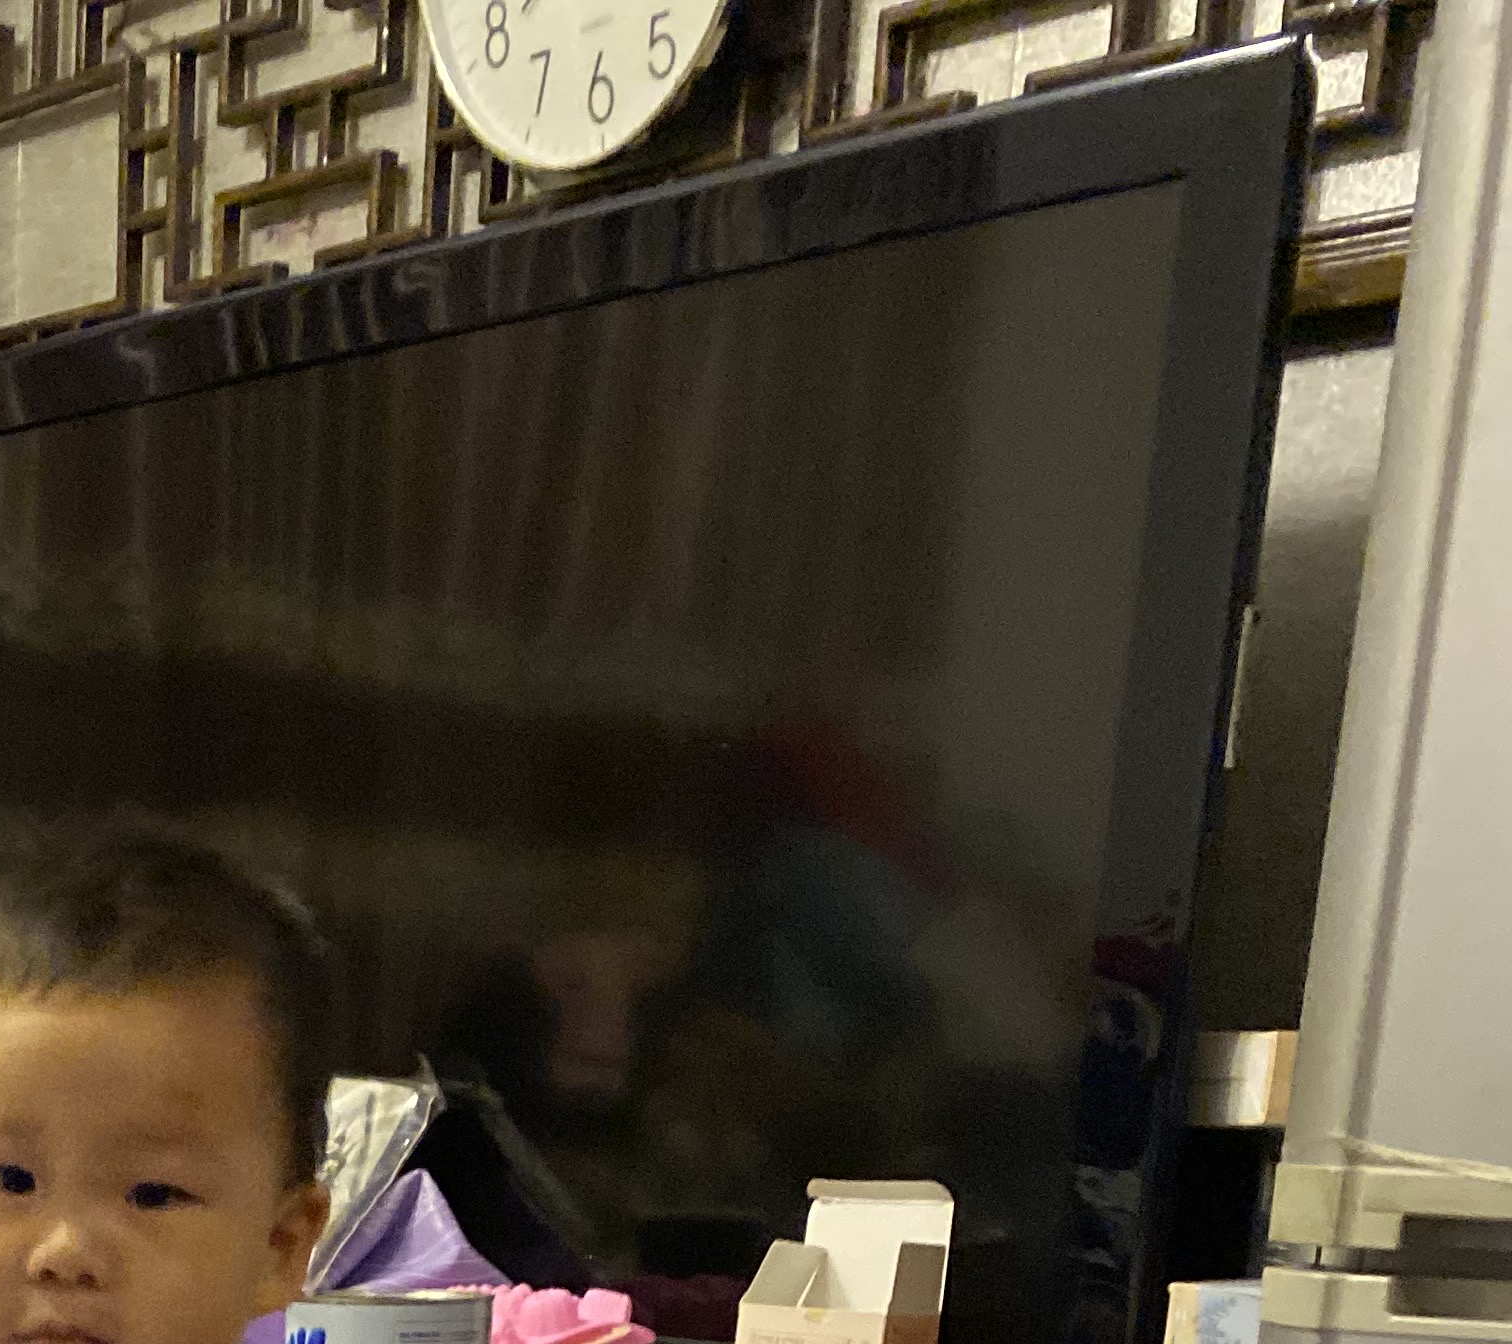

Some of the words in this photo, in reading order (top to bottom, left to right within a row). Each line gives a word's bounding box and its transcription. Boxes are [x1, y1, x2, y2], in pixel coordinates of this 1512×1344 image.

[485, 0, 510, 69] 8
[648, 9, 677, 80] 5
[529, 48, 552, 119] 7
[588, 50, 615, 125] 6
